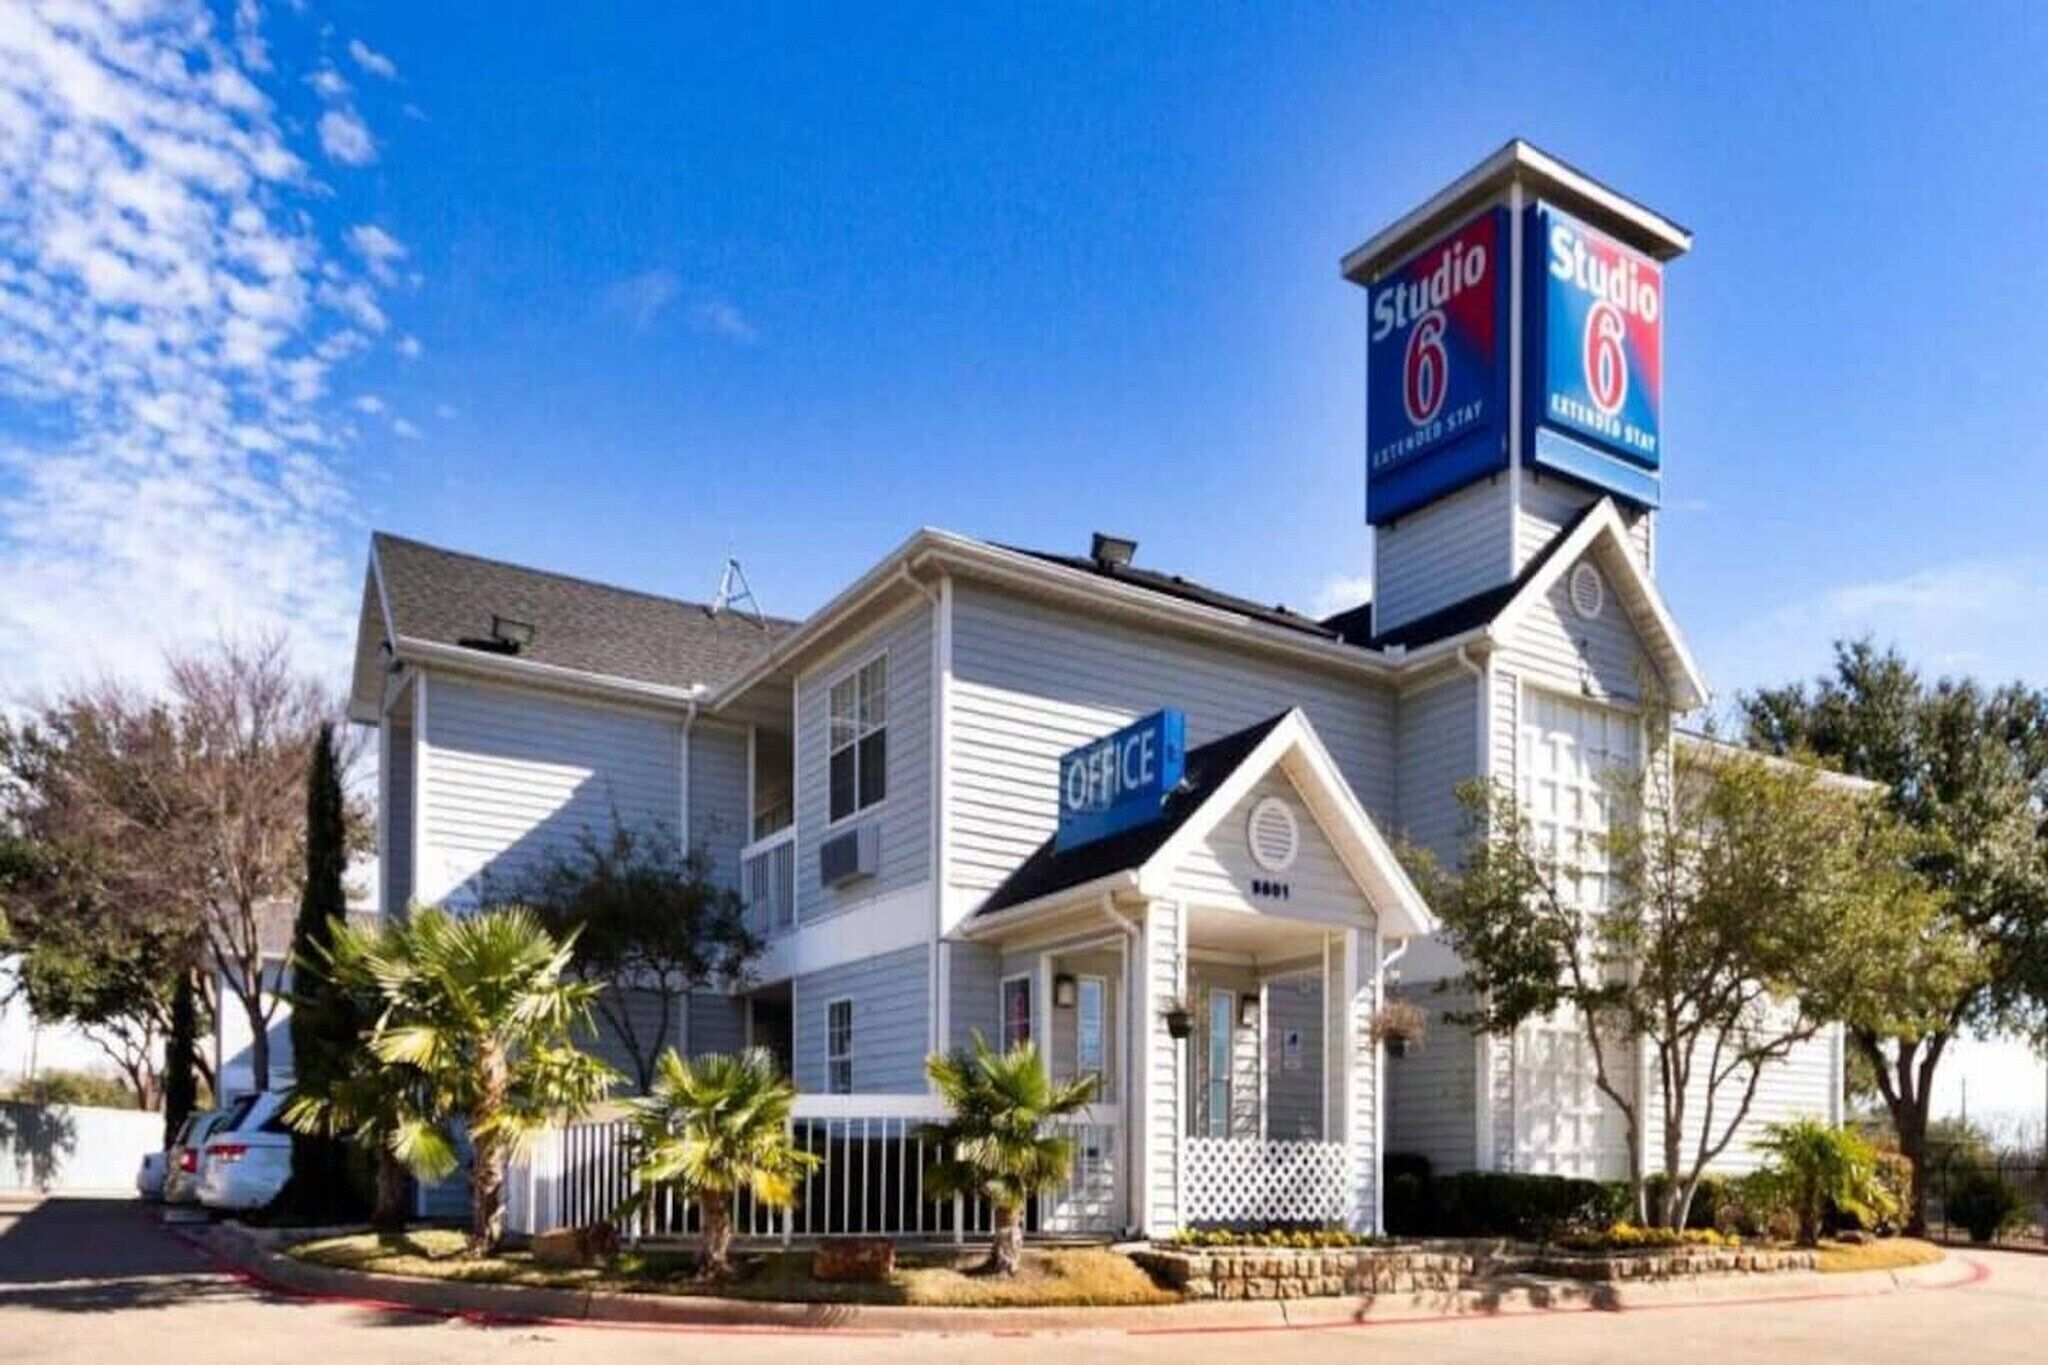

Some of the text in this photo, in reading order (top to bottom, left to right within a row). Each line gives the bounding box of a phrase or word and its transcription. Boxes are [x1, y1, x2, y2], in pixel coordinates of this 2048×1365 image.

[1372, 242, 1486, 341] Studio
[1549, 224, 1658, 323] Studio
[1404, 310, 1448, 425] 6
[1584, 300, 1628, 414] 6
[1372, 399, 1483, 469] EXTENDED STAY
[1551, 393, 1657, 453] EXTENDED STAY
[1067, 730, 1155, 810] OFFICE
